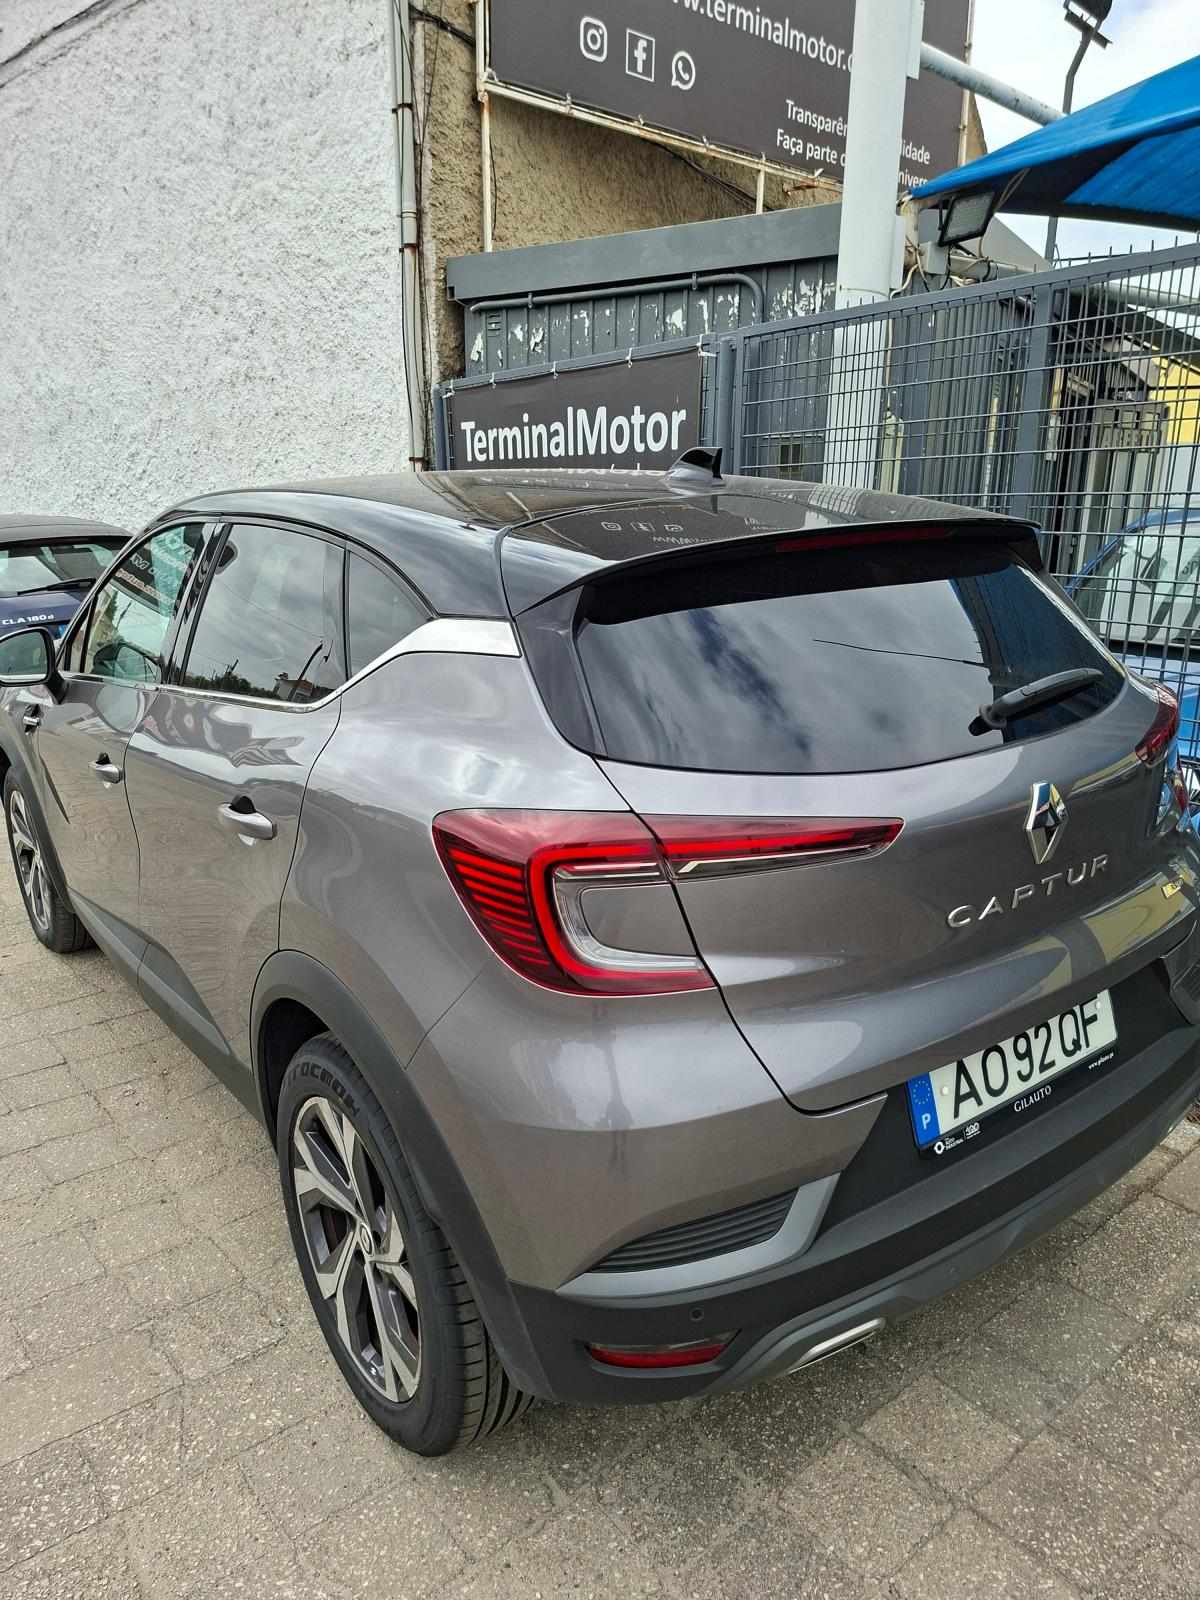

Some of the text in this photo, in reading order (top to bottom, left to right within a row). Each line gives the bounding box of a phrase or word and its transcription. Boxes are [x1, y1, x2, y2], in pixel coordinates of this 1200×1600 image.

[777, 128, 803, 156] Faça
[806, 142, 838, 164] parte
[461, 405, 686, 462] TerminalMotor
[947, 853, 1109, 928] CAPTUR
[1014, 1084, 1052, 1112] GILAUTO
[921, 1113, 931, 1130] P
